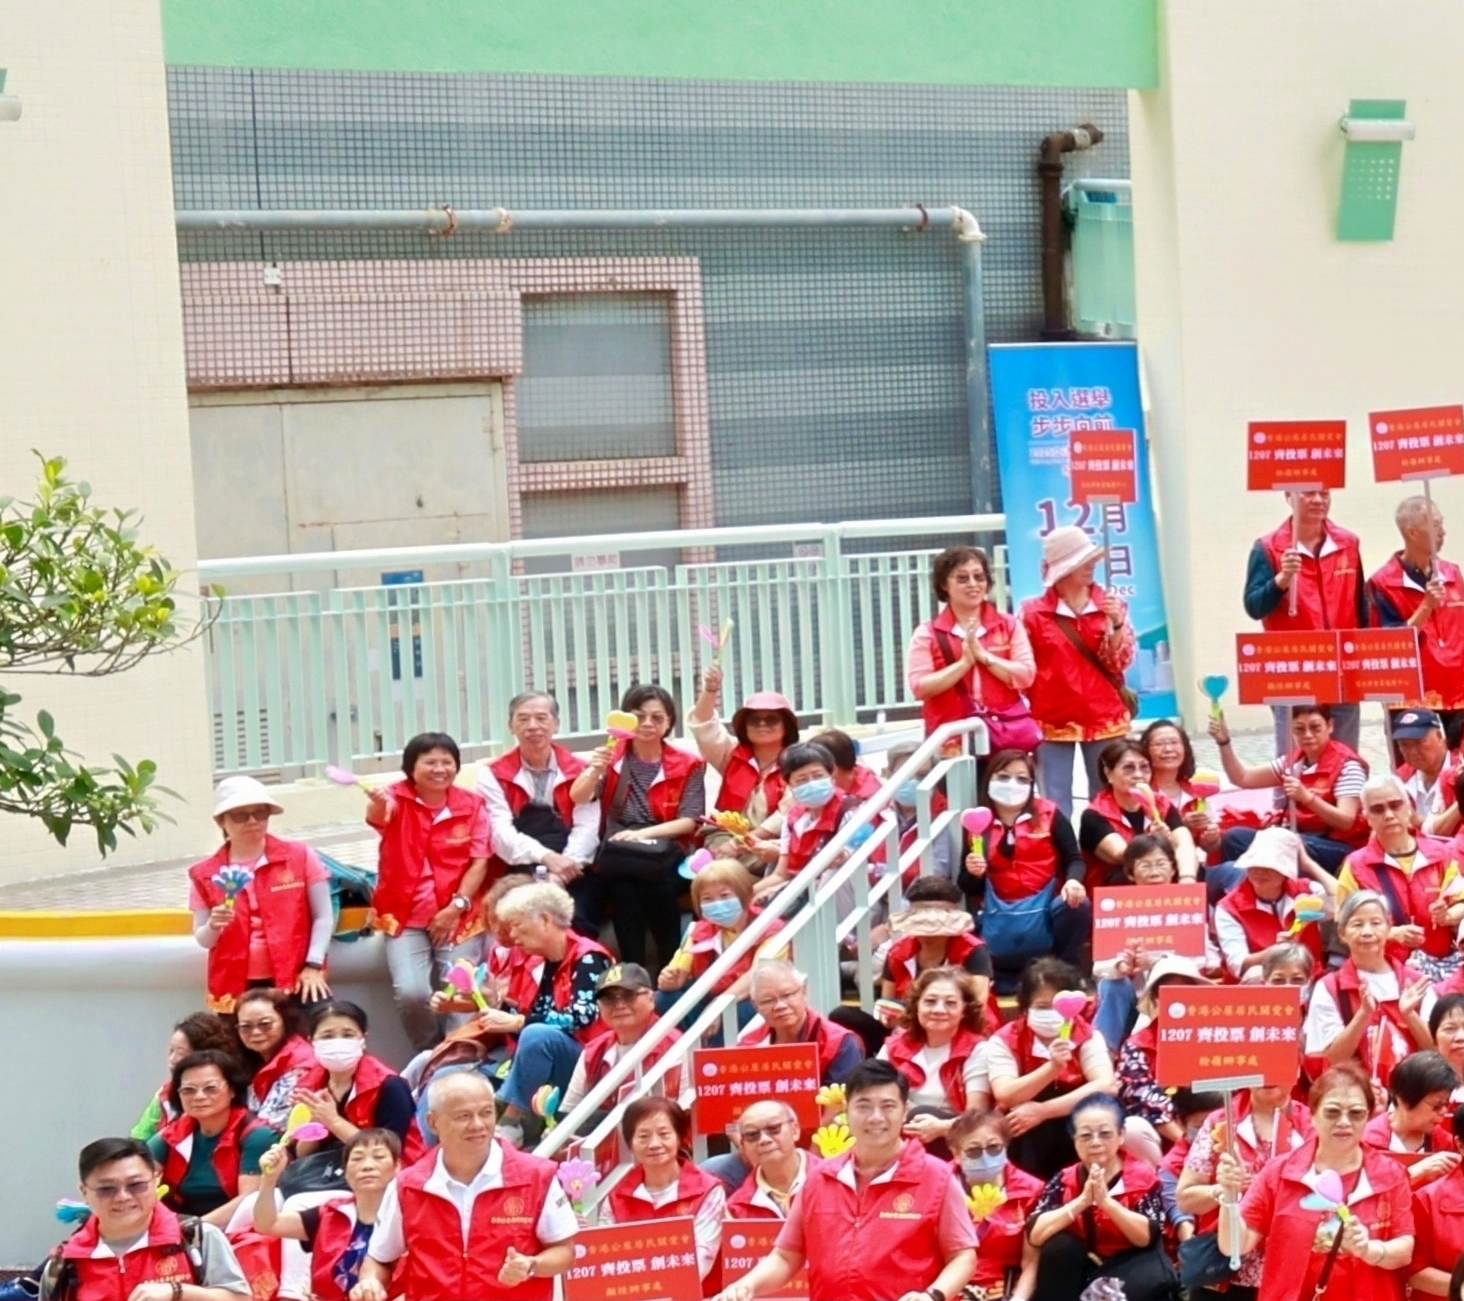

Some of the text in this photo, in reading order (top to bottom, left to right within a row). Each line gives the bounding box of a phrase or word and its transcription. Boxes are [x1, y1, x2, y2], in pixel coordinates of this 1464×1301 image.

[1030, 389, 1111, 411] 投入選舉
[1185, 1004, 1293, 1016] 香港公屋居民關愛會
[1161, 1026, 1295, 1042] 1207 齊投票 創未來
[567, 1252, 694, 1279] 1207 齊投票 創未來
